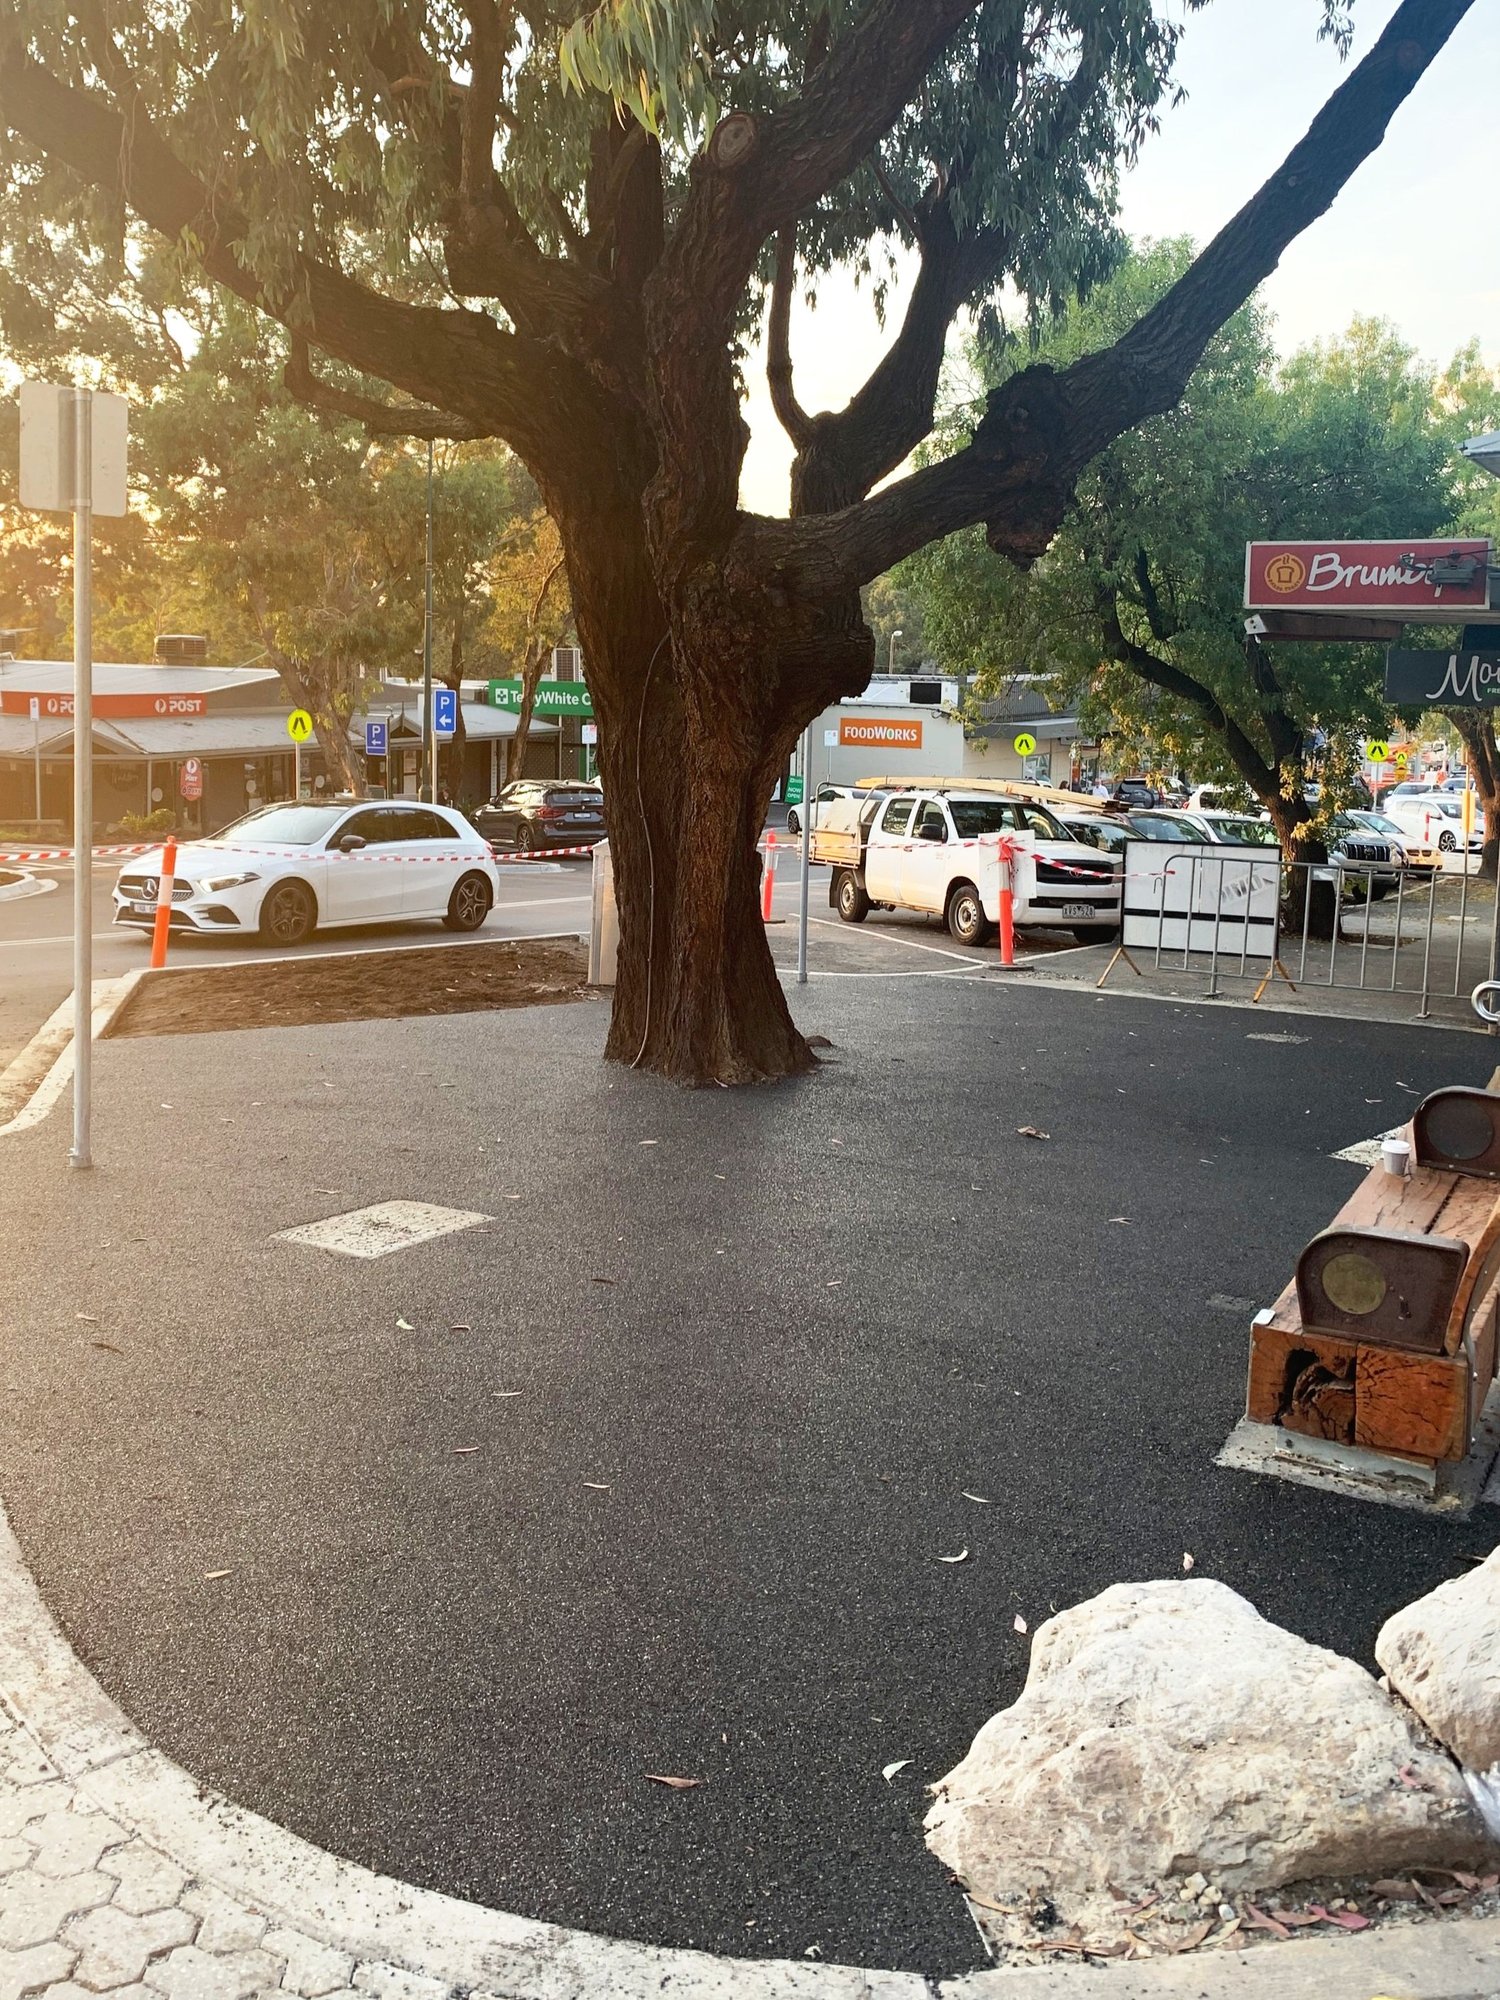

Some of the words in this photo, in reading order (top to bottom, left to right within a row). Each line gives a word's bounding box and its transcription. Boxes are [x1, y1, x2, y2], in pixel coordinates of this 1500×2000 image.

[440, 696, 450, 710] P
[510, 690, 579, 707] TeyWhite
[60, 700, 75, 713] PO
[169, 699, 202, 712] POST
[372, 725, 381, 738] P
[844, 726, 917, 741] FOODWORKS
